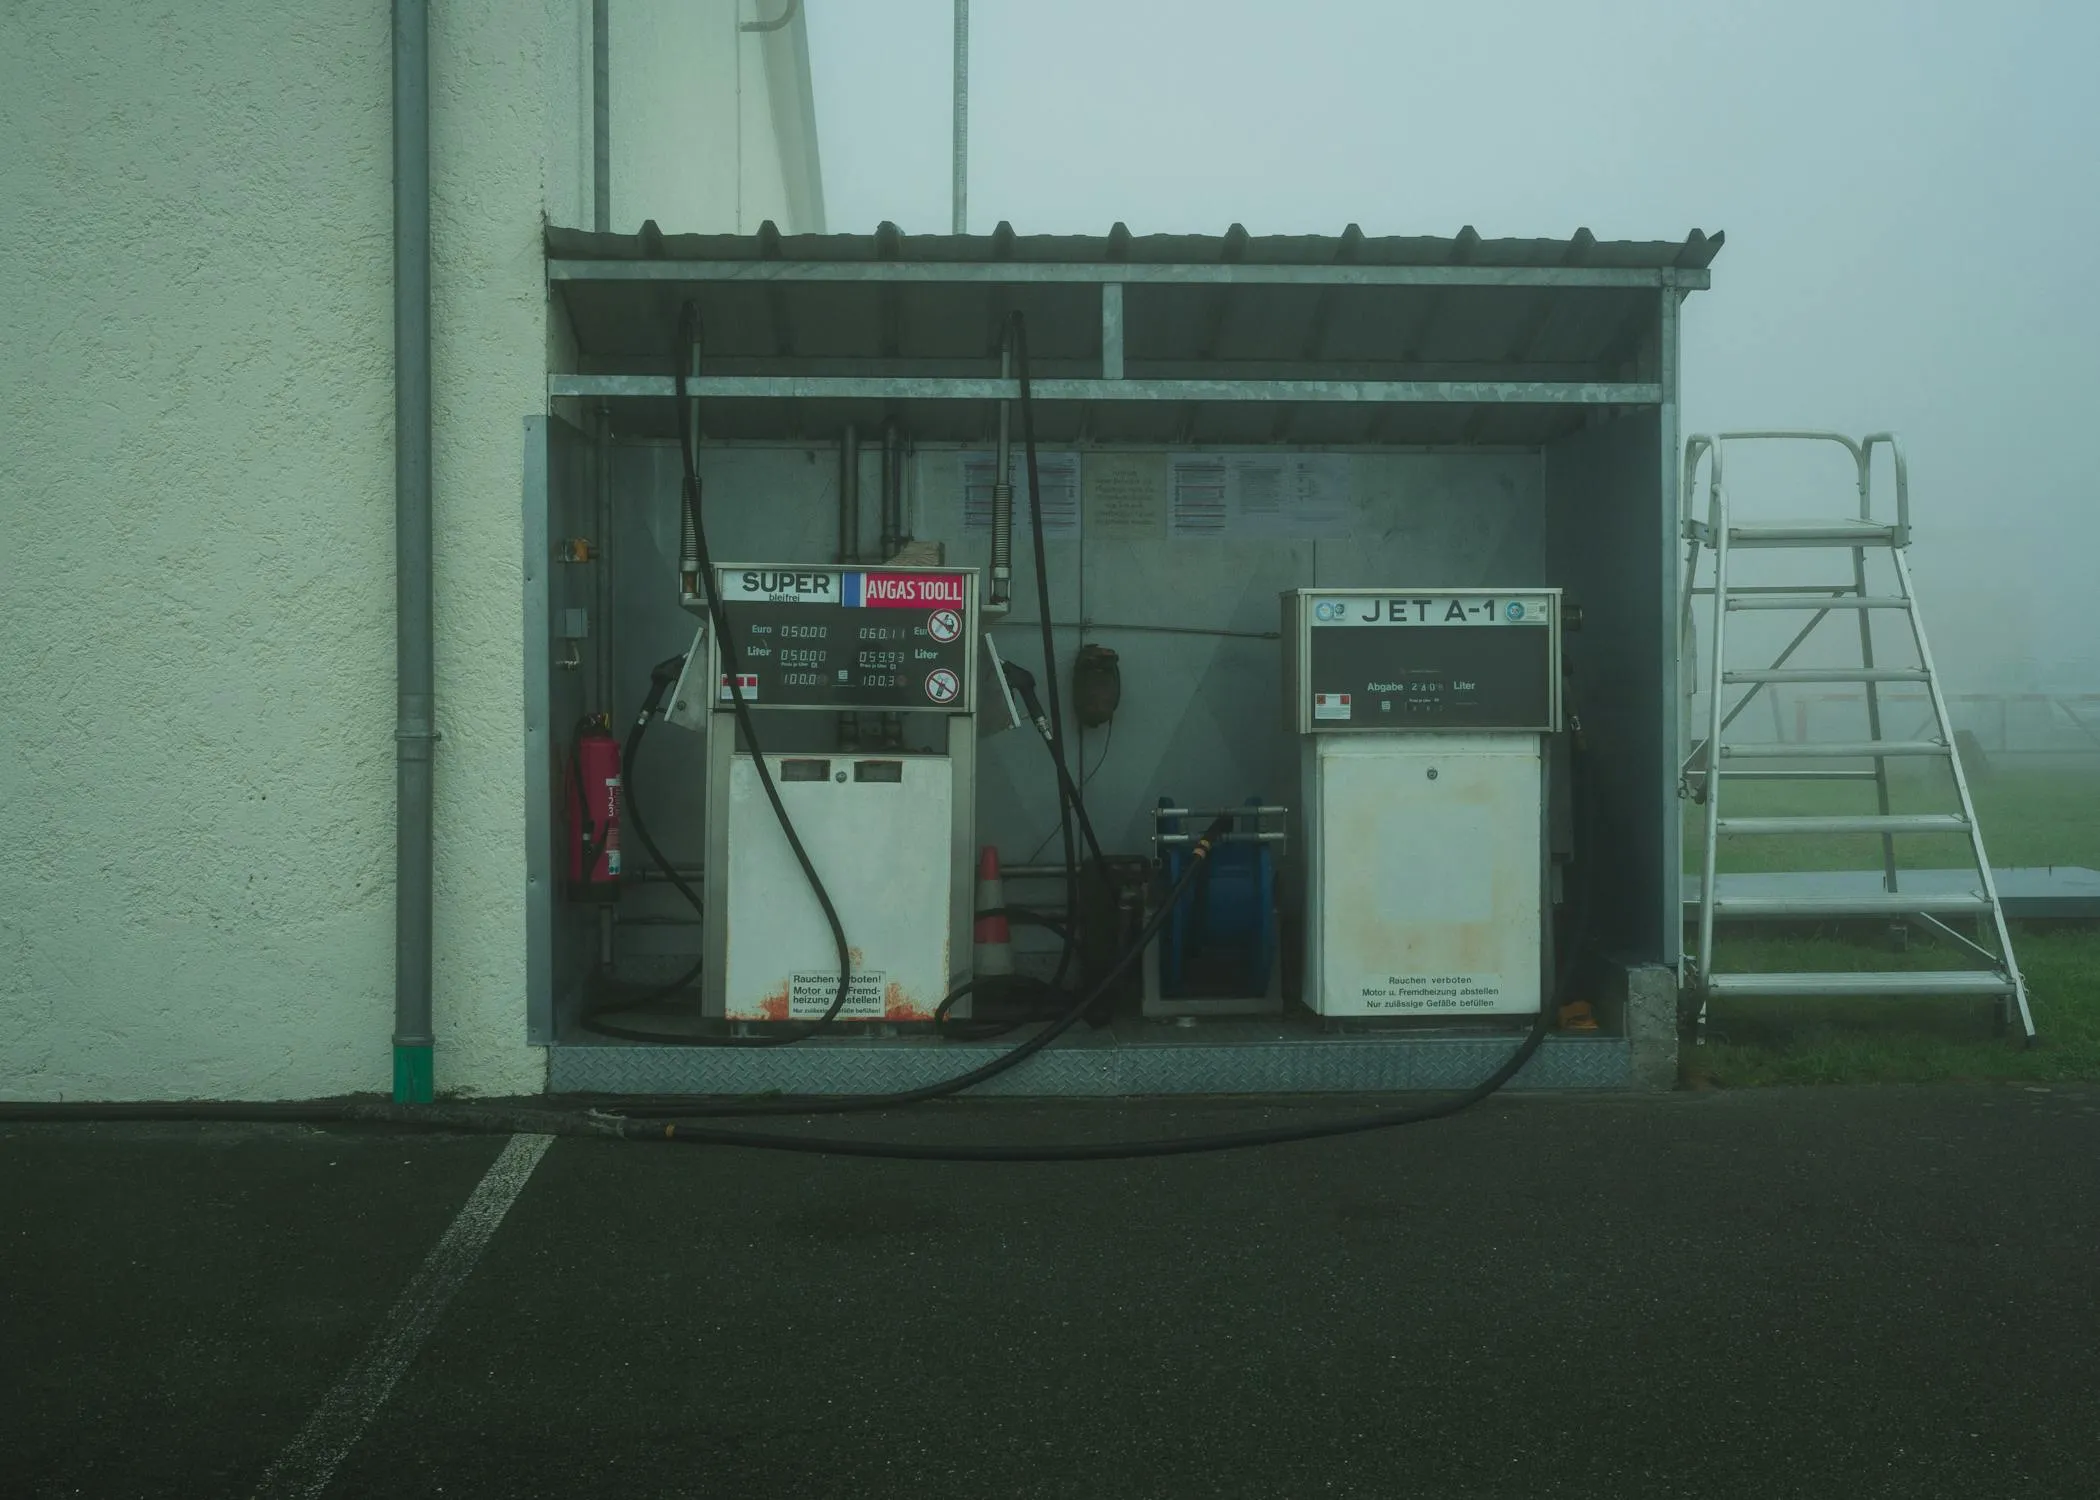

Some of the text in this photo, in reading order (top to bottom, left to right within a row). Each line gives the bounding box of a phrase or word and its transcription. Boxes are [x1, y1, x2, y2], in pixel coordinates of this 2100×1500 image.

[742, 572, 830, 594] SUPER
[867, 579, 962, 601] AVGAS 100LL
[769, 593, 800, 602] bleifrei
[1361, 599, 1495, 622] JET A-1
[751, 624, 772, 634] Euro
[913, 626, 928, 636] Eur
[747, 646, 773, 657] Liter
[914, 648, 939, 659] Liter
[1367, 682, 1404, 692] Abgabe
[1453, 680, 1476, 690] Liter
[793, 975, 881, 983] Rauchen vboten!
[1388, 976, 1472, 984] Rauchen verboten
[793, 986, 822, 995] Motor
[847, 986, 880, 995] Fremd-
[1362, 988, 1387, 996] Motor
[1398, 988, 1457, 997] Fremdheizung
[1459, 987, 1499, 995] abstellen
[793, 995, 829, 1006] heizung
[1366, 999, 1494, 1009] Nur zulässige Gefäße befüllen
